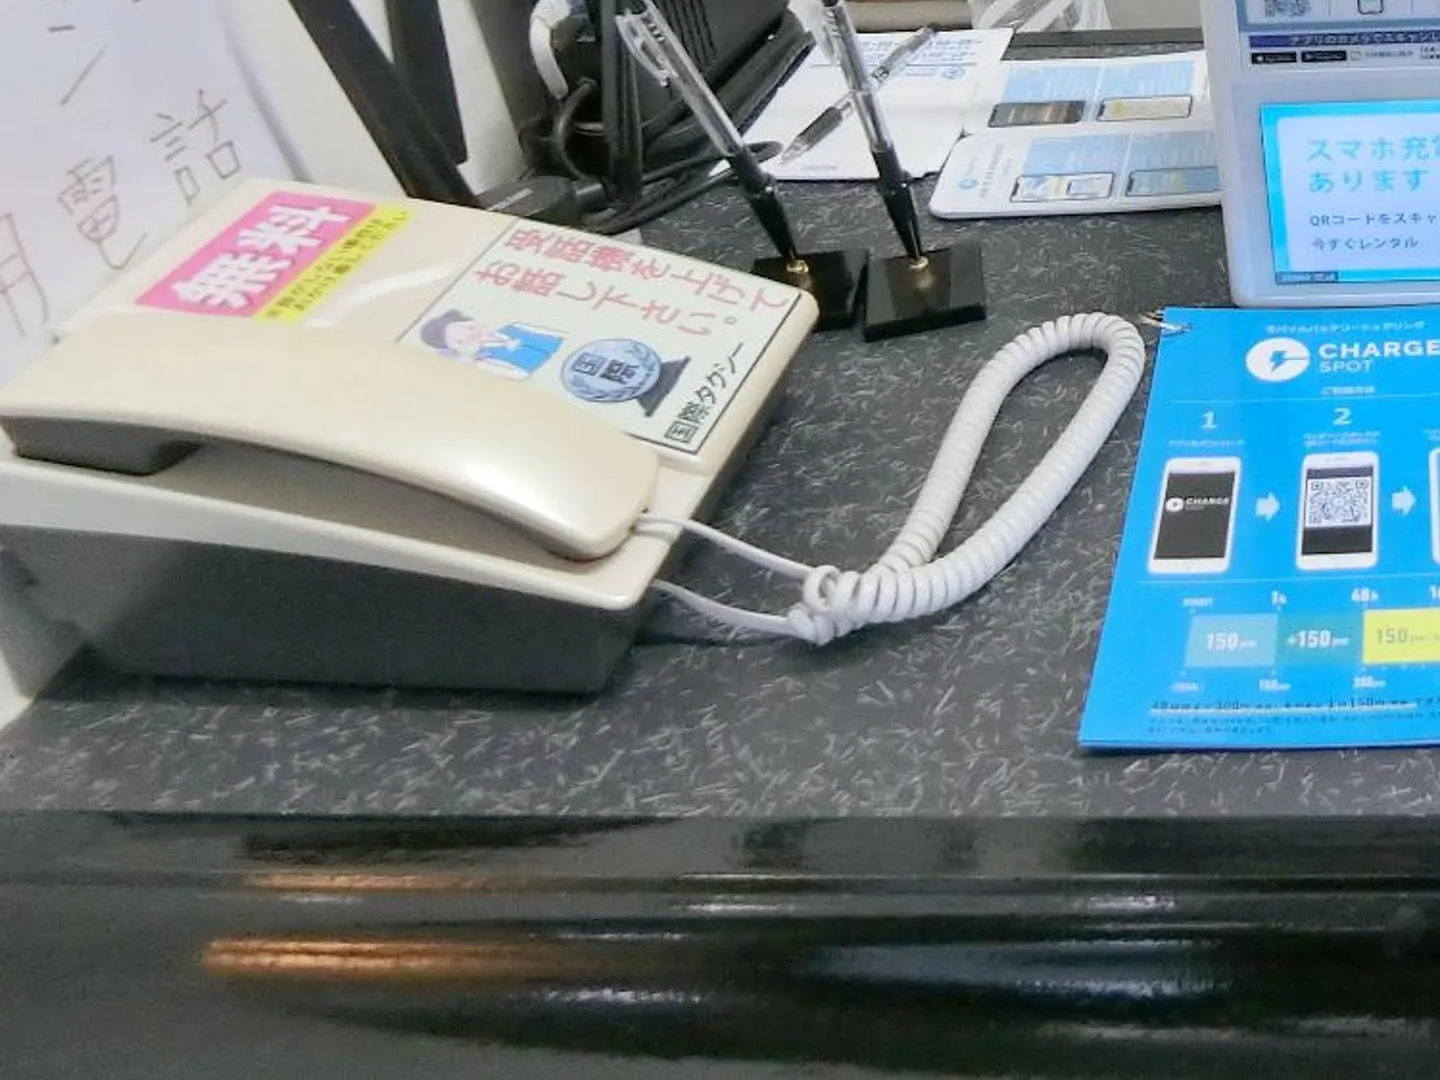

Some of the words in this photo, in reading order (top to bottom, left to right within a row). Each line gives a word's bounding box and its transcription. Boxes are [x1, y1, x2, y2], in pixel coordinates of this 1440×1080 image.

[1308, 167, 1430, 194] あります
[1311, 236, 1420, 252] 今すぐレンタル
[172, 204, 353, 311] 無料
[503, 227, 789, 312] 受話器を上げて
[1318, 358, 1375, 375] SPOT
[664, 341, 744, 444] 国際タクシー
[1200, 411, 1219, 430] 1
[1332, 408, 1353, 426] 2
